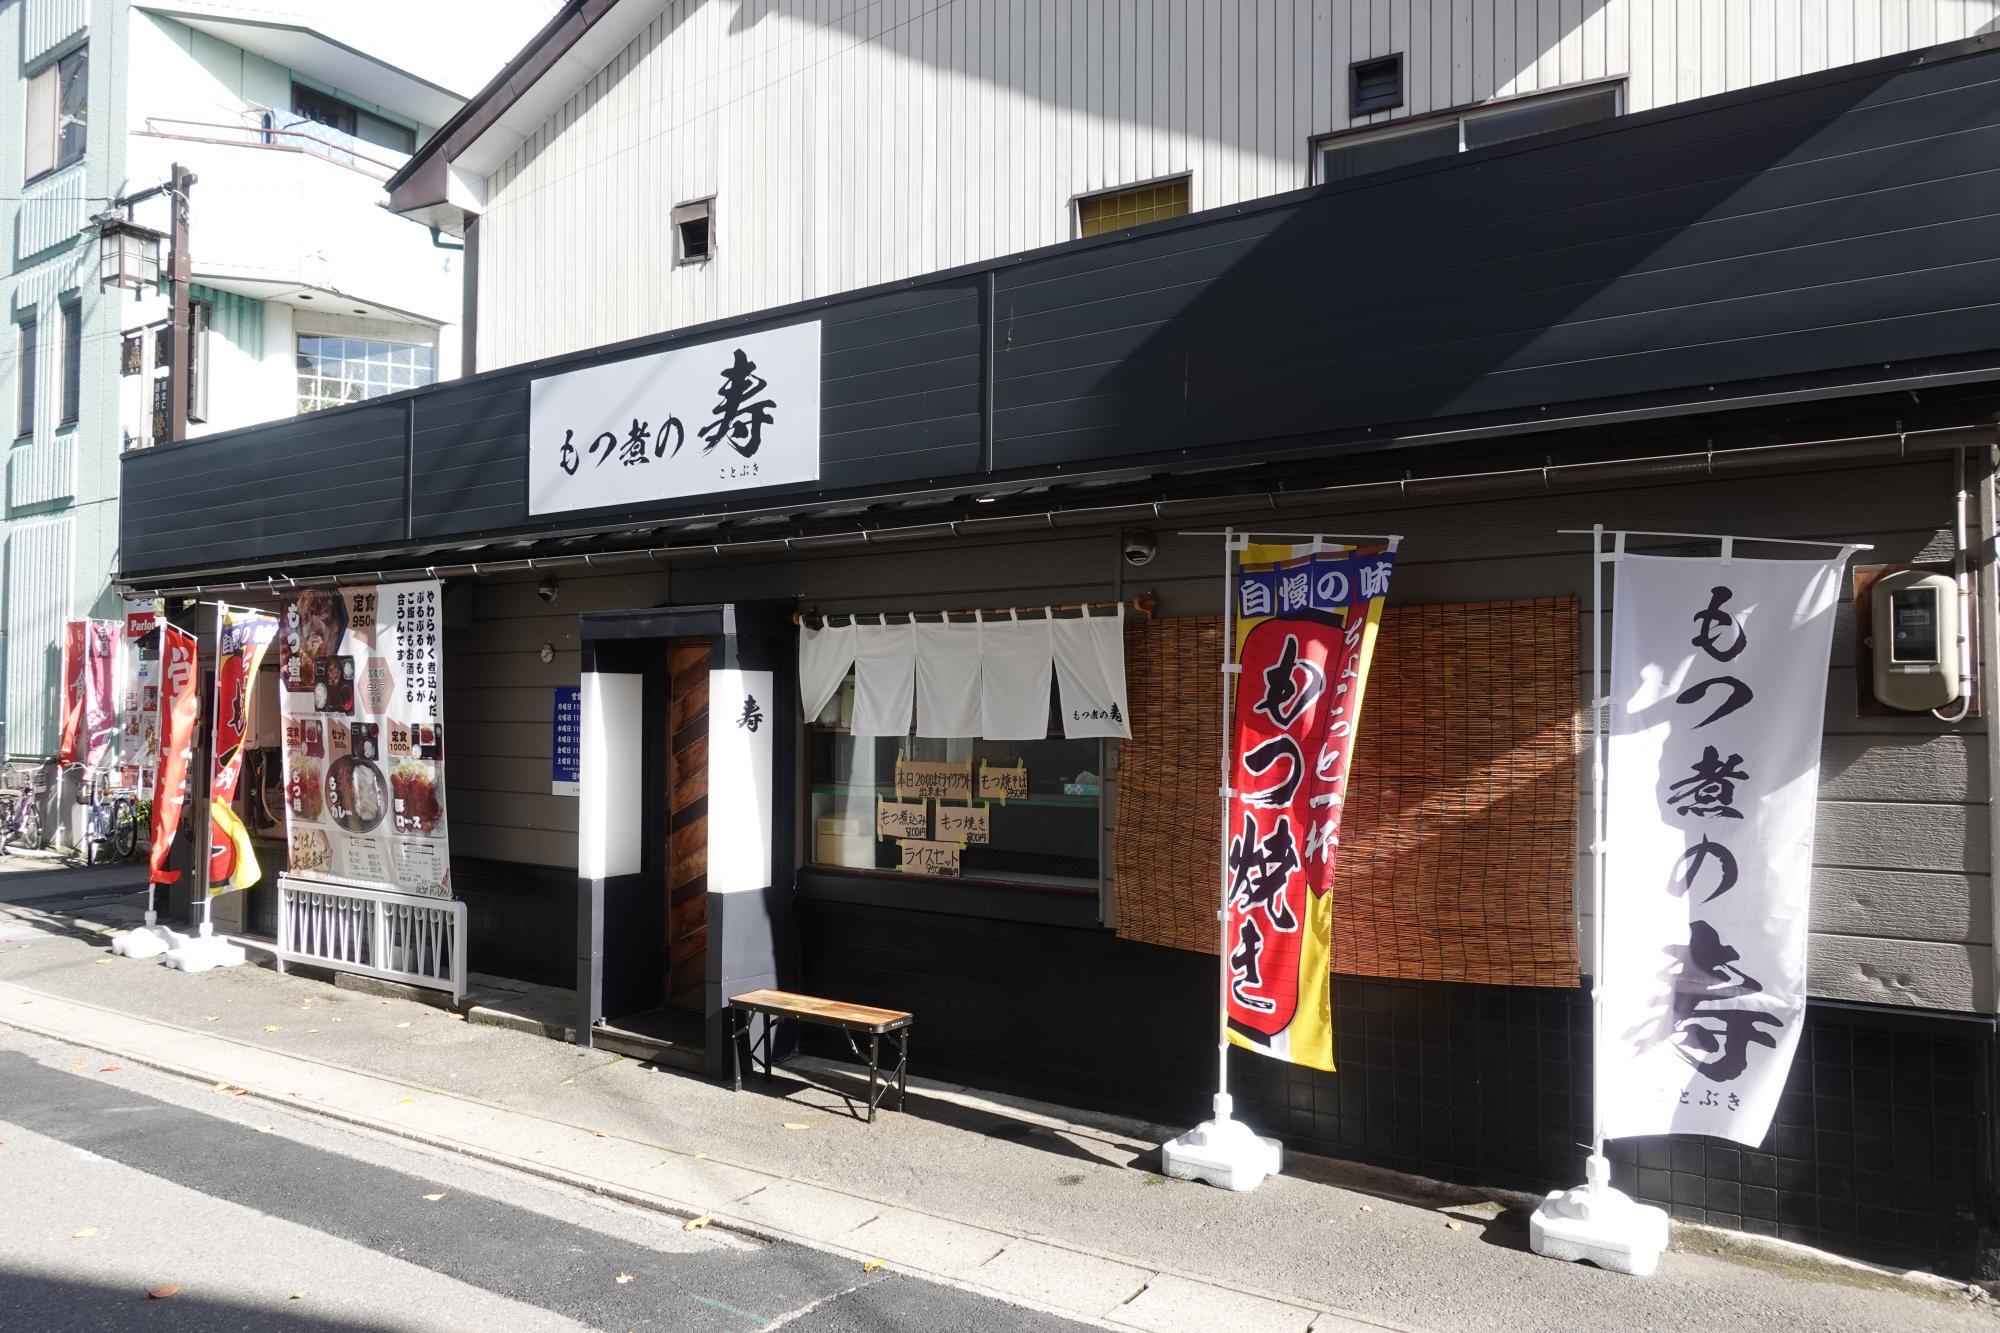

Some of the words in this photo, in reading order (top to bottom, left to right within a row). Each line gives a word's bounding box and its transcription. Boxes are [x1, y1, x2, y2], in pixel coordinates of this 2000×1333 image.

[720, 463, 759, 479] ことぶき
[1241, 561, 1392, 617] 自慢の味
[353, 593, 376, 612] 定食
[352, 615, 375, 628] 950円
[287, 603, 301, 682] もつ煮
[736, 694, 764, 733] 寿
[1073, 701, 1122, 723] もつ煮の寿
[332, 729, 346, 740] セット
[391, 731, 407, 742] 定食
[1305, 617, 1363, 863] ちょこっと一杯
[389, 743, 409, 751] 1000円
[919, 787, 949, 797] 出来ます
[331, 806, 352, 819] カレー
[880, 809, 926, 826] もつ煮込み
[396, 815, 422, 829] ロース
[940, 813, 986, 831] もつ焼き
[1229, 634, 1327, 1012] もつ焼き
[905, 827, 926, 838] 800円
[1620, 585, 1784, 1083] もつ煮の寿
[904, 847, 958, 867] ライスセット
